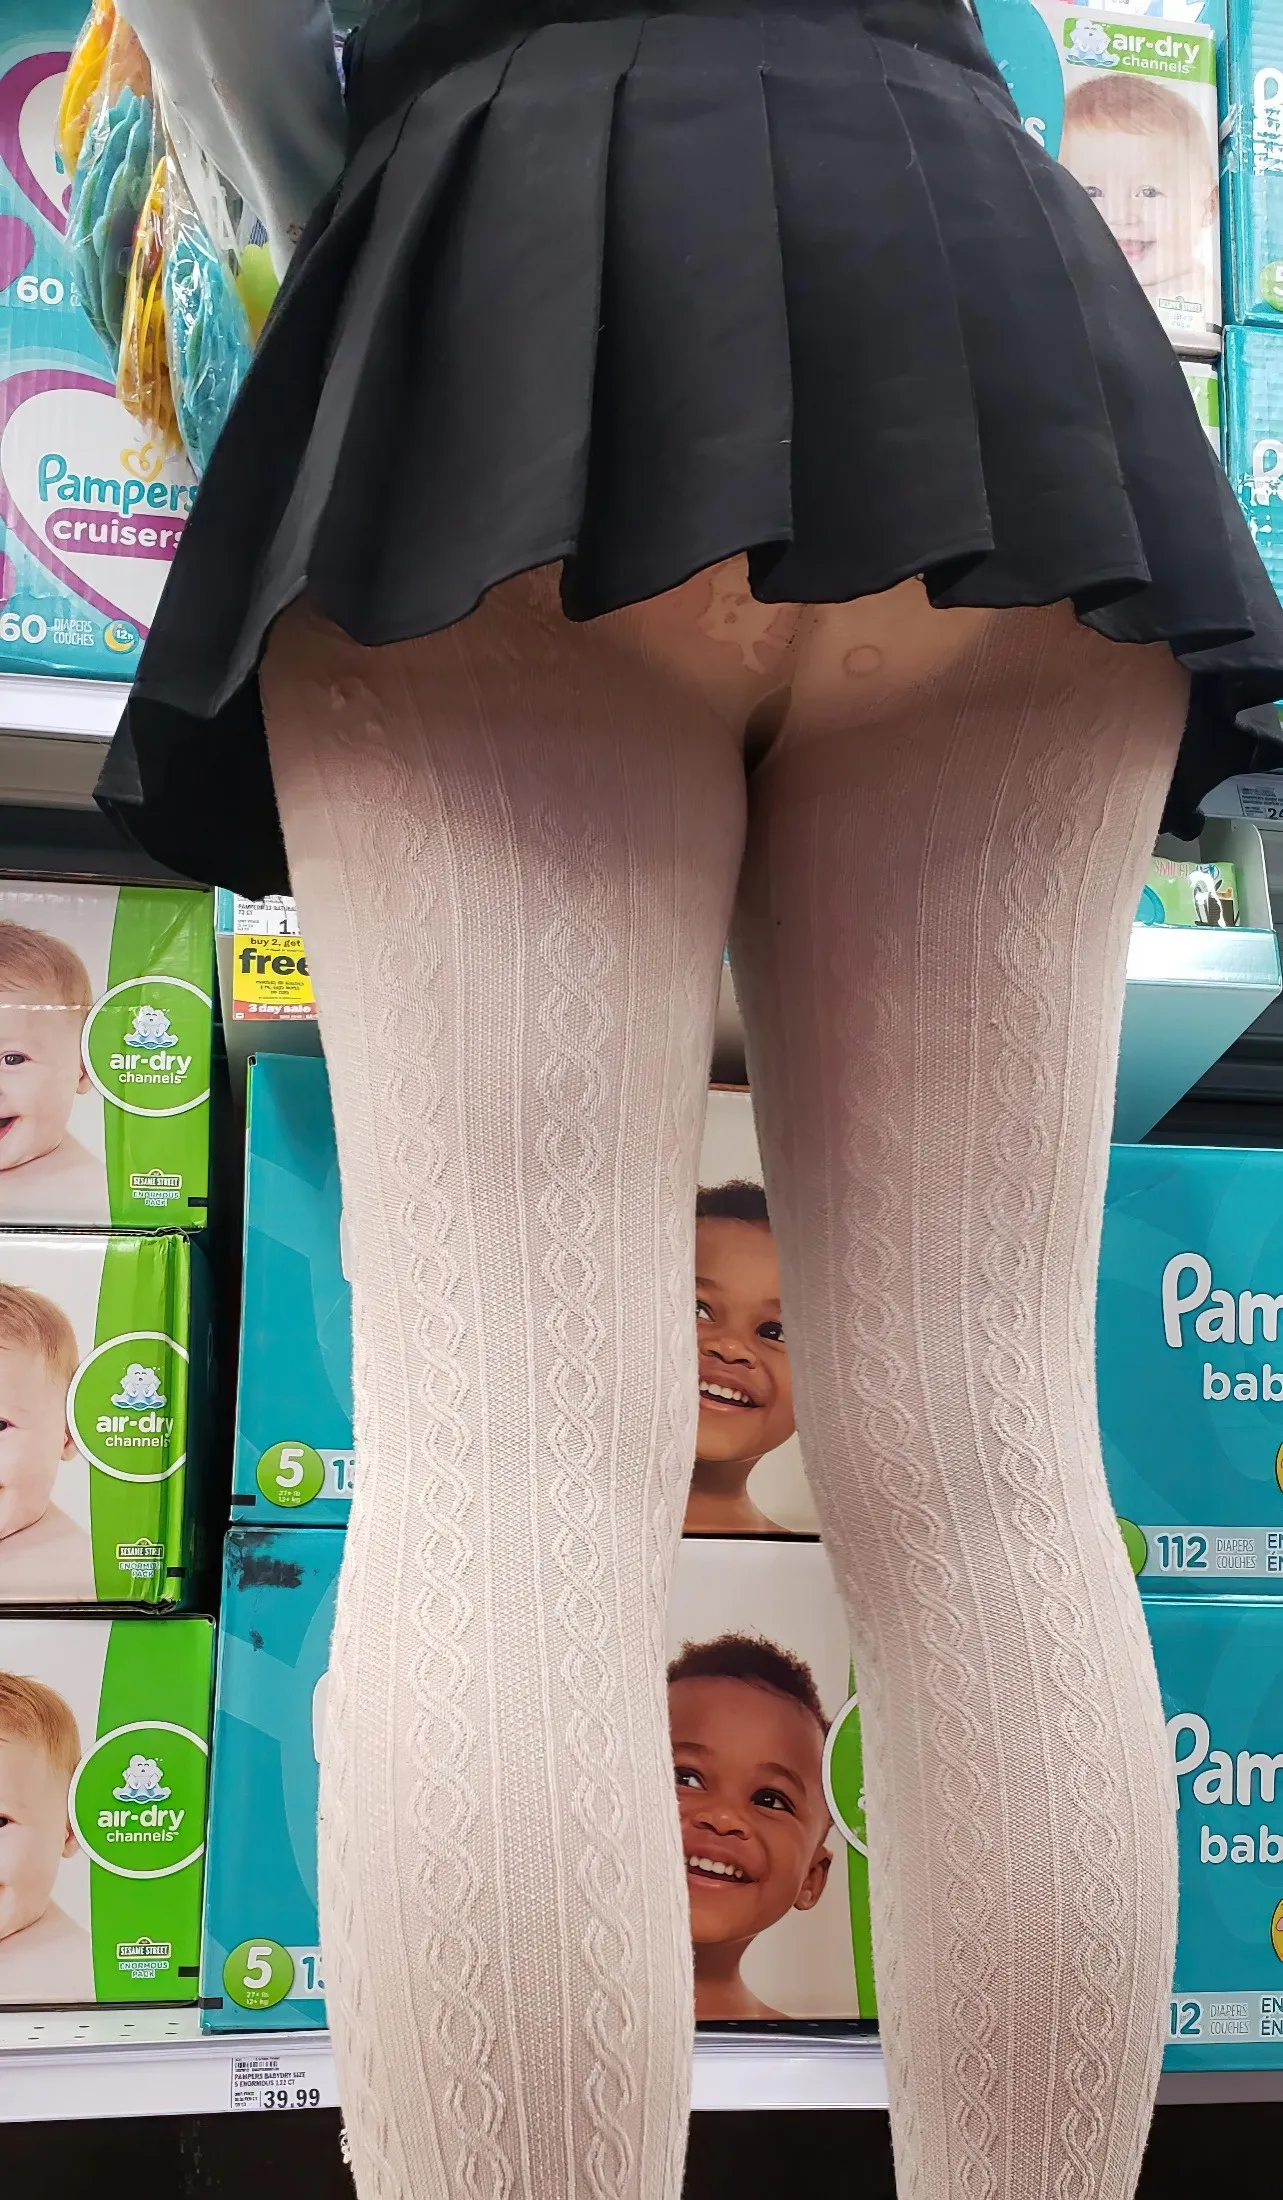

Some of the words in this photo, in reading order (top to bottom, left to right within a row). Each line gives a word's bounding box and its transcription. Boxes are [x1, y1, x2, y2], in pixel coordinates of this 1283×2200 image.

[1112, 33, 1199, 64] air-dry
[1122, 55, 1190, 73] channels
[16, 275, 64, 305] 60
[38, 453, 199, 515] Pampers
[0, 612, 47, 644] 60
[54, 618, 93, 633] DIAPERS
[53, 632, 95, 646] COUCHES
[280, 919, 301, 935] 1.
[250, 938, 270, 947] buy
[248, 1003, 258, 1013] 3
[258, 1003, 282, 1014] day
[283, 1004, 312, 1013] sale
[109, 1051, 192, 1075] air-dry
[118, 1072, 182, 1084] channels
[133, 1177, 156, 1186] SESAME
[157, 1177, 178, 1187] STREET
[1162, 1252, 1283, 1348] Pam
[1203, 1362, 1283, 1401] bab
[96, 1412, 173, 1438] air-dry
[276, 1448, 304, 1488] 5
[121, 1547, 144, 1556] SESAME
[144, 1547, 162, 1556] STRE
[1157, 1535, 1207, 1568] 112
[1217, 1539, 1254, 1552] DIAPERS
[119, 1562, 160, 1570] ENORMO
[1217, 1555, 1256, 1569] COUCHES
[1165, 1713, 1283, 1810] Pam
[97, 1804, 185, 1832] air-dry
[106, 1829, 174, 1842] channels
[1200, 1825, 1283, 1864] bab
[121, 1946, 145, 1955] SESAME
[145, 1946, 168, 1955] STREET
[119, 1962, 169, 1970] ENORMOUS
[243, 1946, 272, 1989] 5
[302, 1956, 325, 1990] 1
[1211, 2004, 1248, 2017] DIAPERS
[1211, 2021, 1249, 2034] COUCHES
[264, 2088, 320, 2109] 39.99
